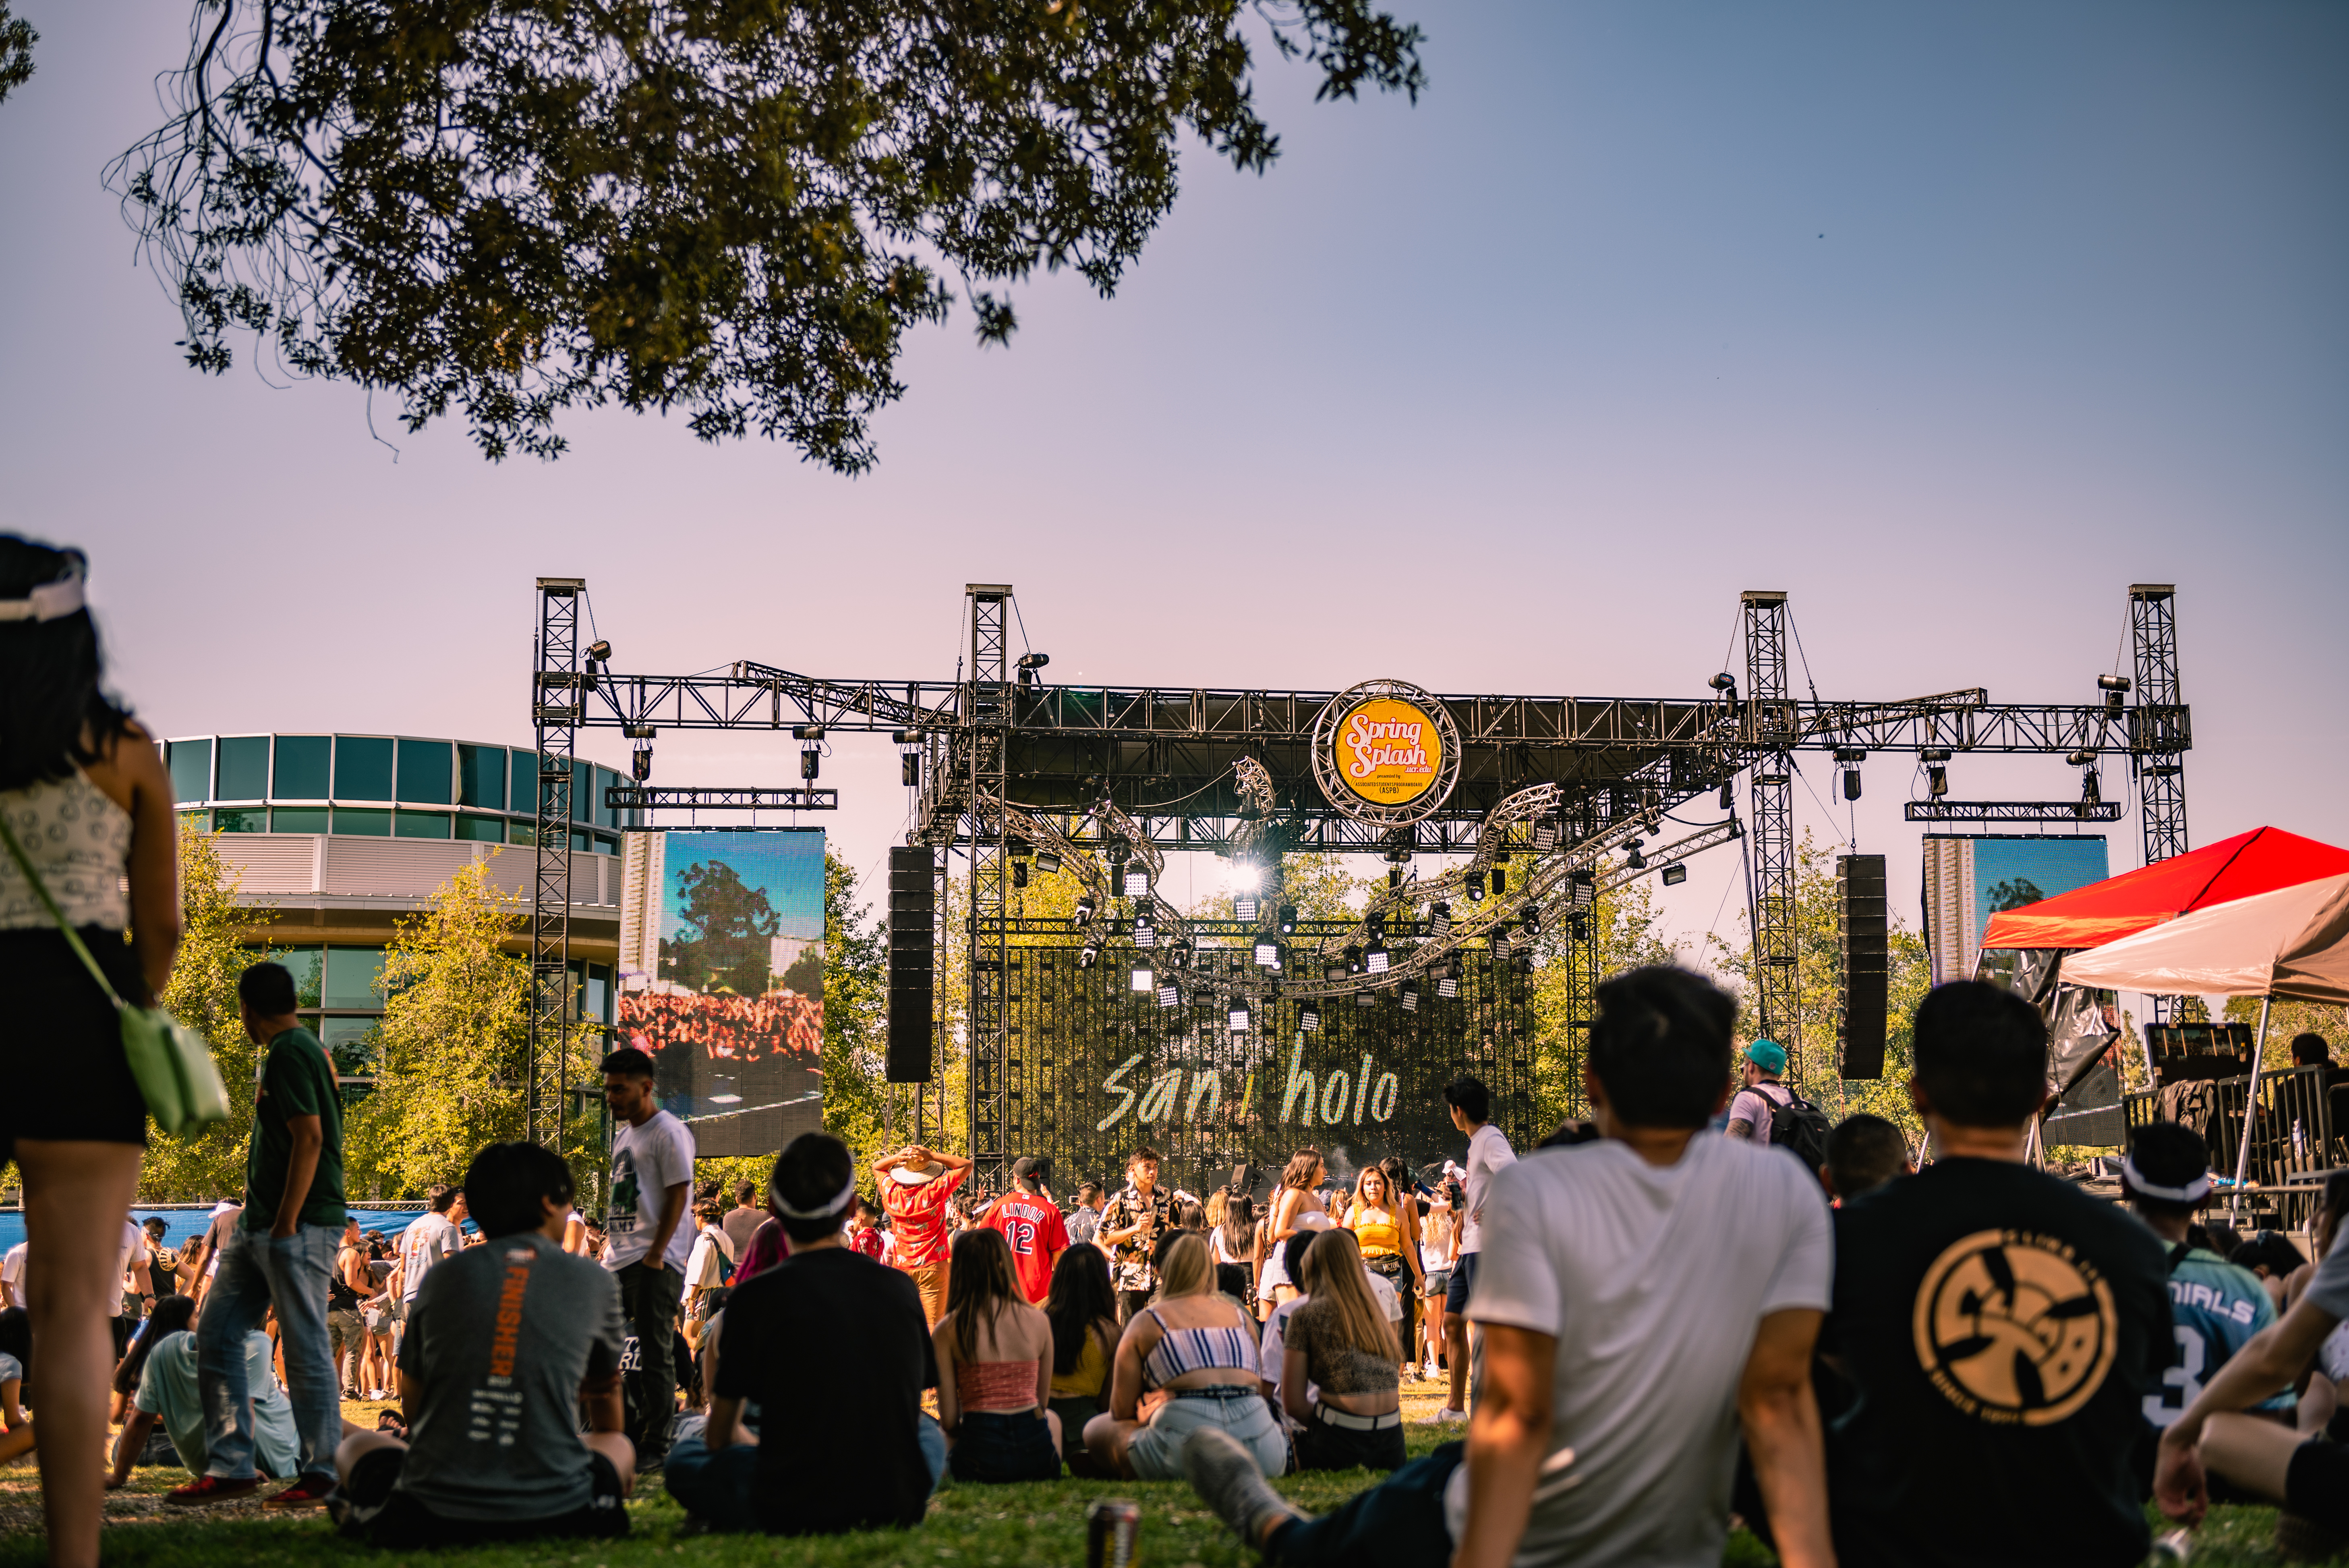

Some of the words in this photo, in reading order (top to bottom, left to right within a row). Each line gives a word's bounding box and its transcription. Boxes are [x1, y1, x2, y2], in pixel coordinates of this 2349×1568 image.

[1346, 714, 1422, 748] Spring
[1349, 744, 1428, 778] Splash
[1404, 765, 1432, 773] .ucr.edu
[1096, 1053, 1221, 1131] san
[1280, 1030, 1398, 1127] holo
[1002, 1203, 1045, 1225] LINDOR
[1006, 1220, 1035, 1255] 12
[489, 1266, 530, 1377] FINISHER
[1216, 1389, 1239, 1397] adidas
